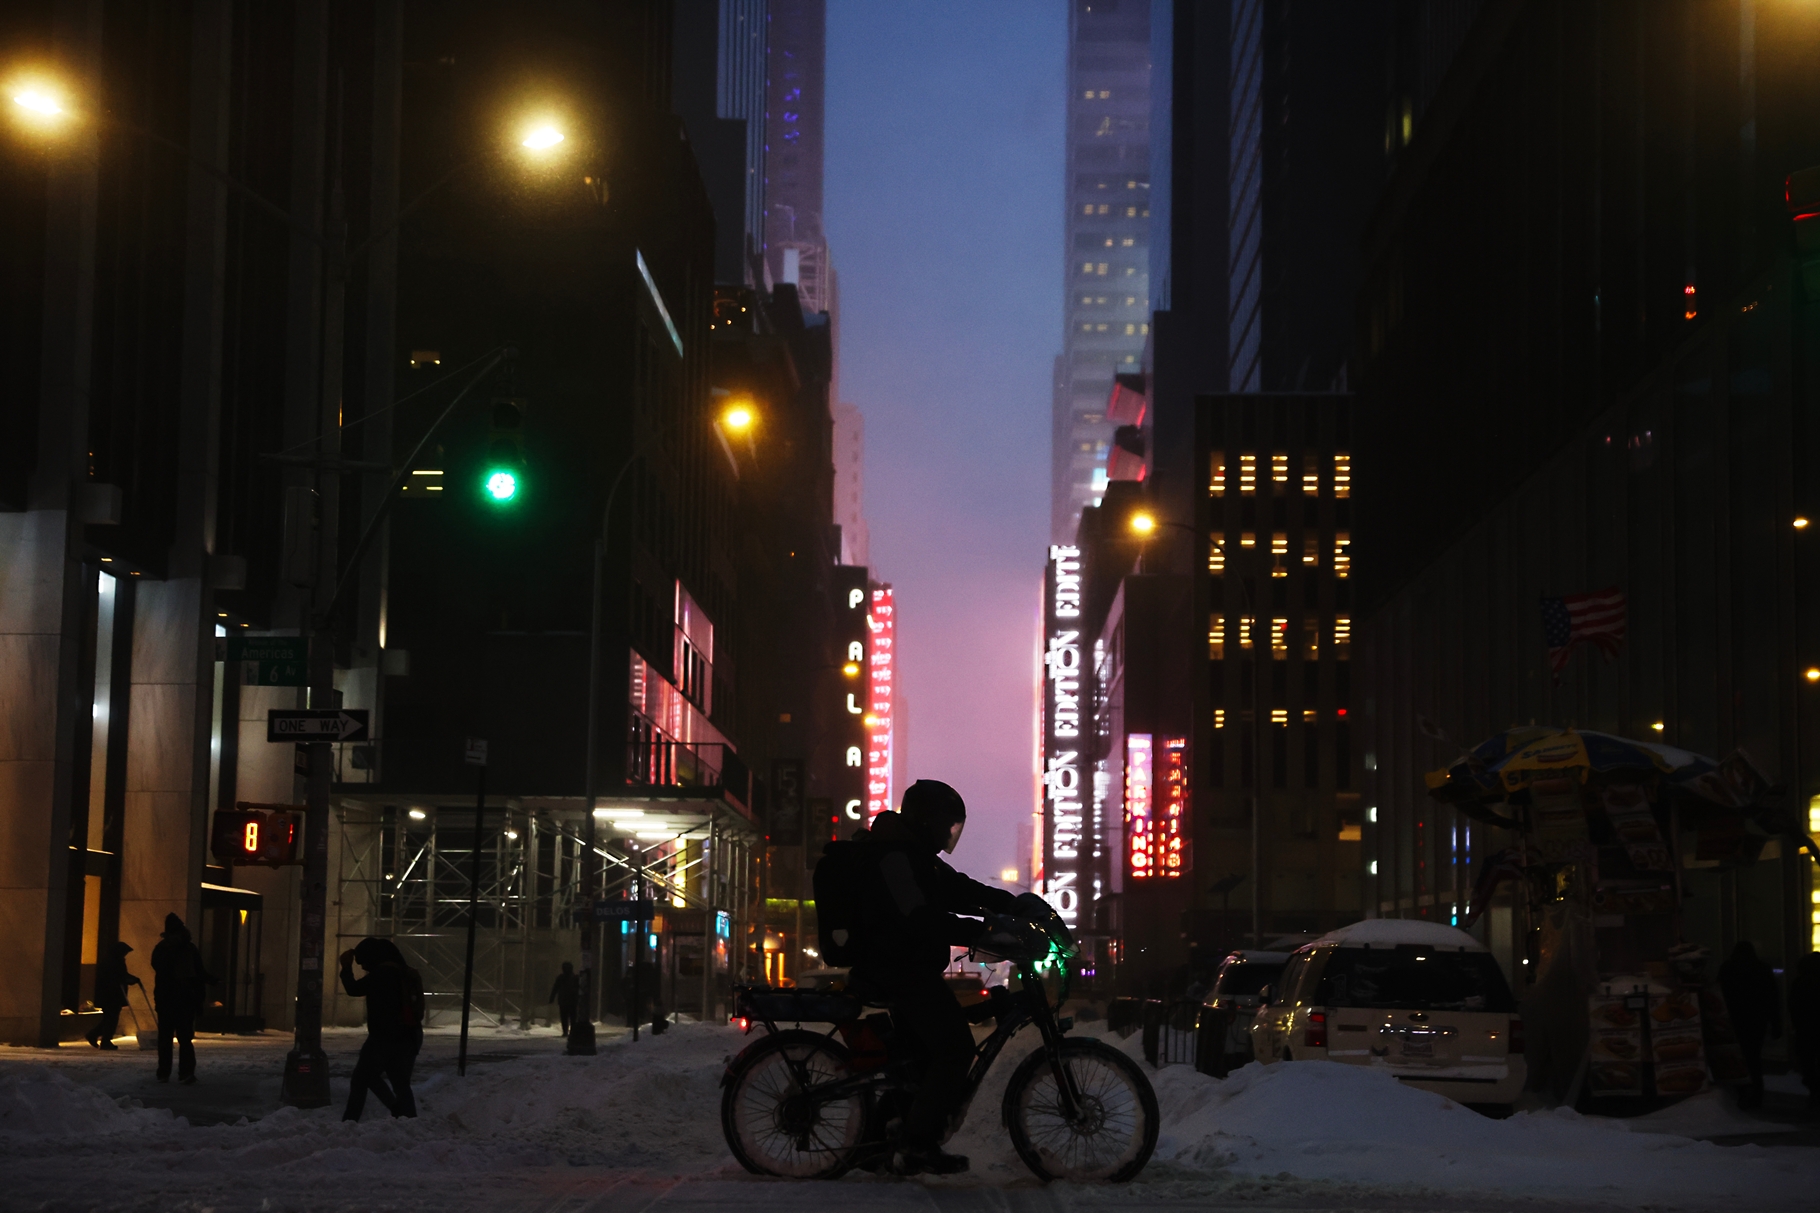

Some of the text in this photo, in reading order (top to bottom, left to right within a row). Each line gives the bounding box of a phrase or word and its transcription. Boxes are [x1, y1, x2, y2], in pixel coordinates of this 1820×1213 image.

[241, 647, 295, 660] Americas
[269, 665, 279, 683] 6
[1054, 630, 1079, 736] EDITION
[279, 719, 350, 732] ONE WAY
[1053, 750, 1080, 858] EDITION
[1131, 752, 1148, 867] PARKING
[244, 821, 260, 852] 8
[596, 906, 631, 916] DELOS
